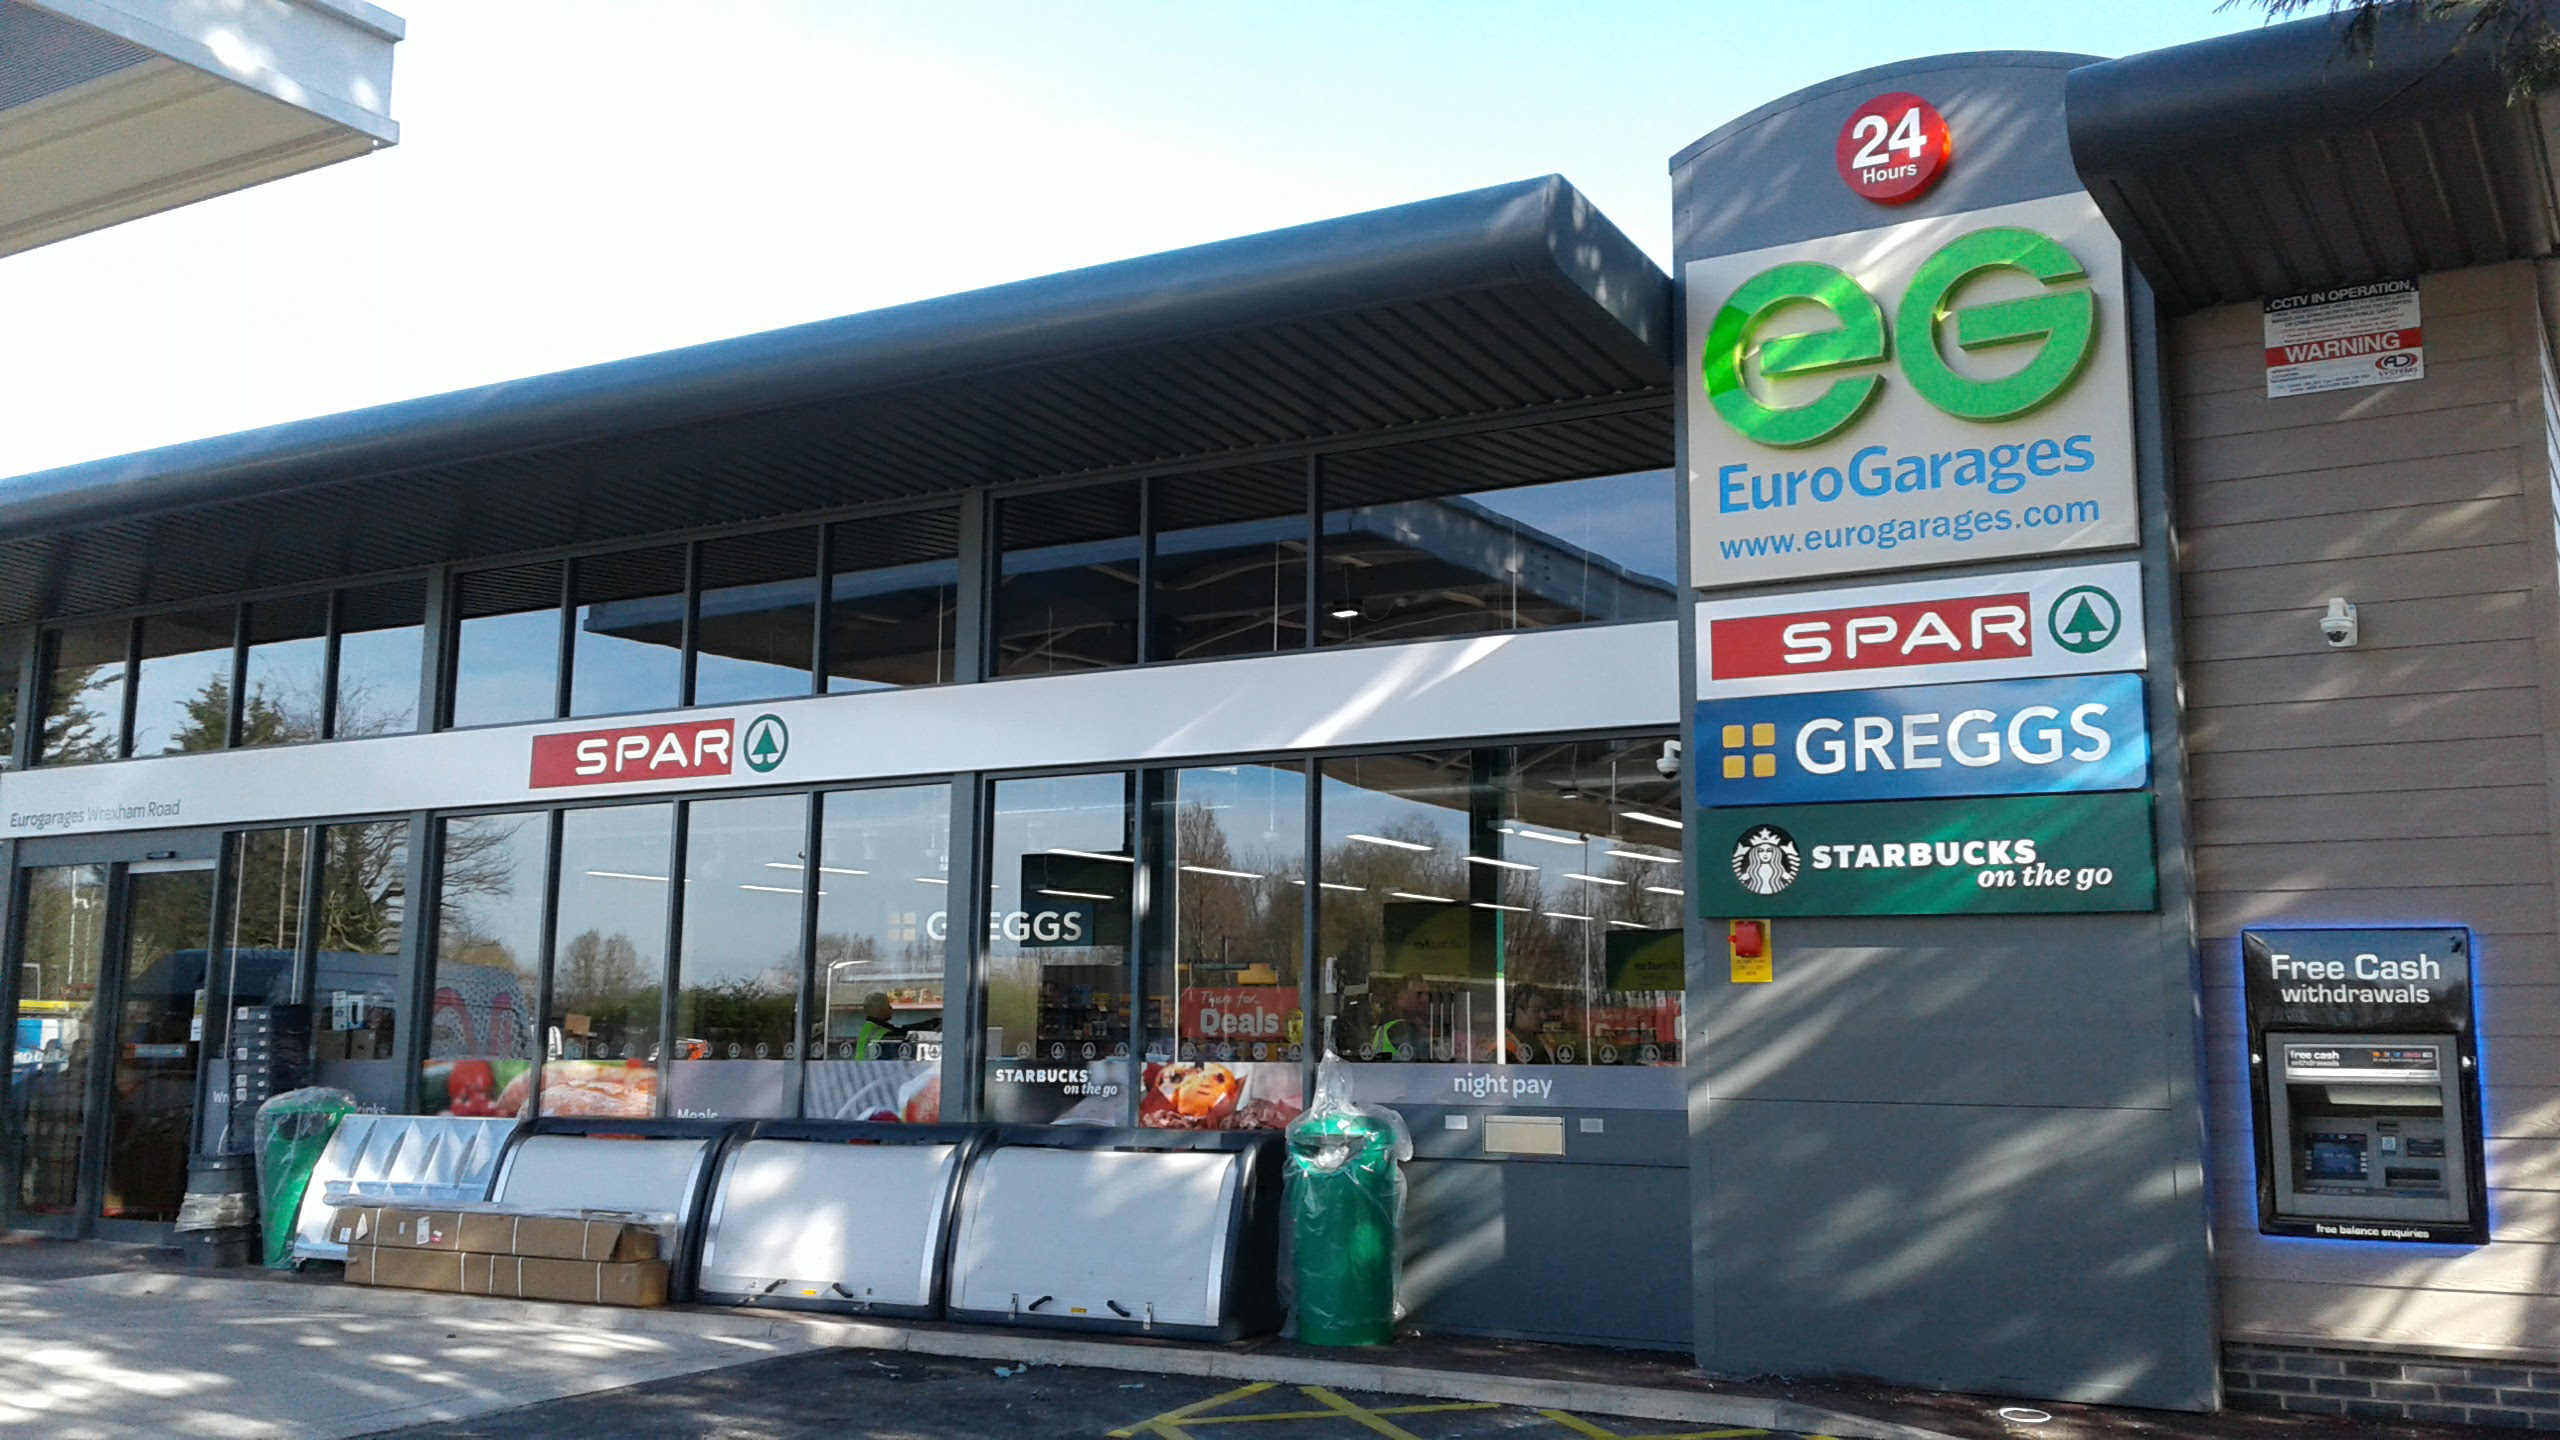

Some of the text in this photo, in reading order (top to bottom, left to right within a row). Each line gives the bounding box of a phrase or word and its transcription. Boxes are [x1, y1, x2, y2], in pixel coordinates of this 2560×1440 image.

[1853, 107, 1927, 169] 24
[1863, 164, 1918, 184] Hours
[2271, 280, 2411, 311] CCTV IN OPERATION
[2285, 332, 2400, 362] WARNING
[1719, 435, 2095, 515] EuroGarages
[1720, 500, 2100, 560] www.eurogarages.com
[1783, 605, 2027, 664] SPAR
[575, 728, 730, 776] SPAR
[1796, 703, 2112, 775] GREGGS
[10, 799, 181, 830] Eurogarages Wrexham Road
[1812, 839, 2037, 869] STARBUCKS
[1978, 862, 2114, 891] on the go
[926, 911, 1082, 942] GEGGS
[2271, 953, 2440, 980] Free Cash
[2281, 983, 2431, 1003] withdrawals
[1200, 1006, 1280, 1034] Deals
[2289, 1050, 2340, 1060] free cash
[995, 1069, 1089, 1082] STARBUCKS
[1063, 1082, 1118, 1097] on the go
[1454, 1072, 1553, 1099] night pay
[2316, 1223, 2430, 1240] free balance enquiries
